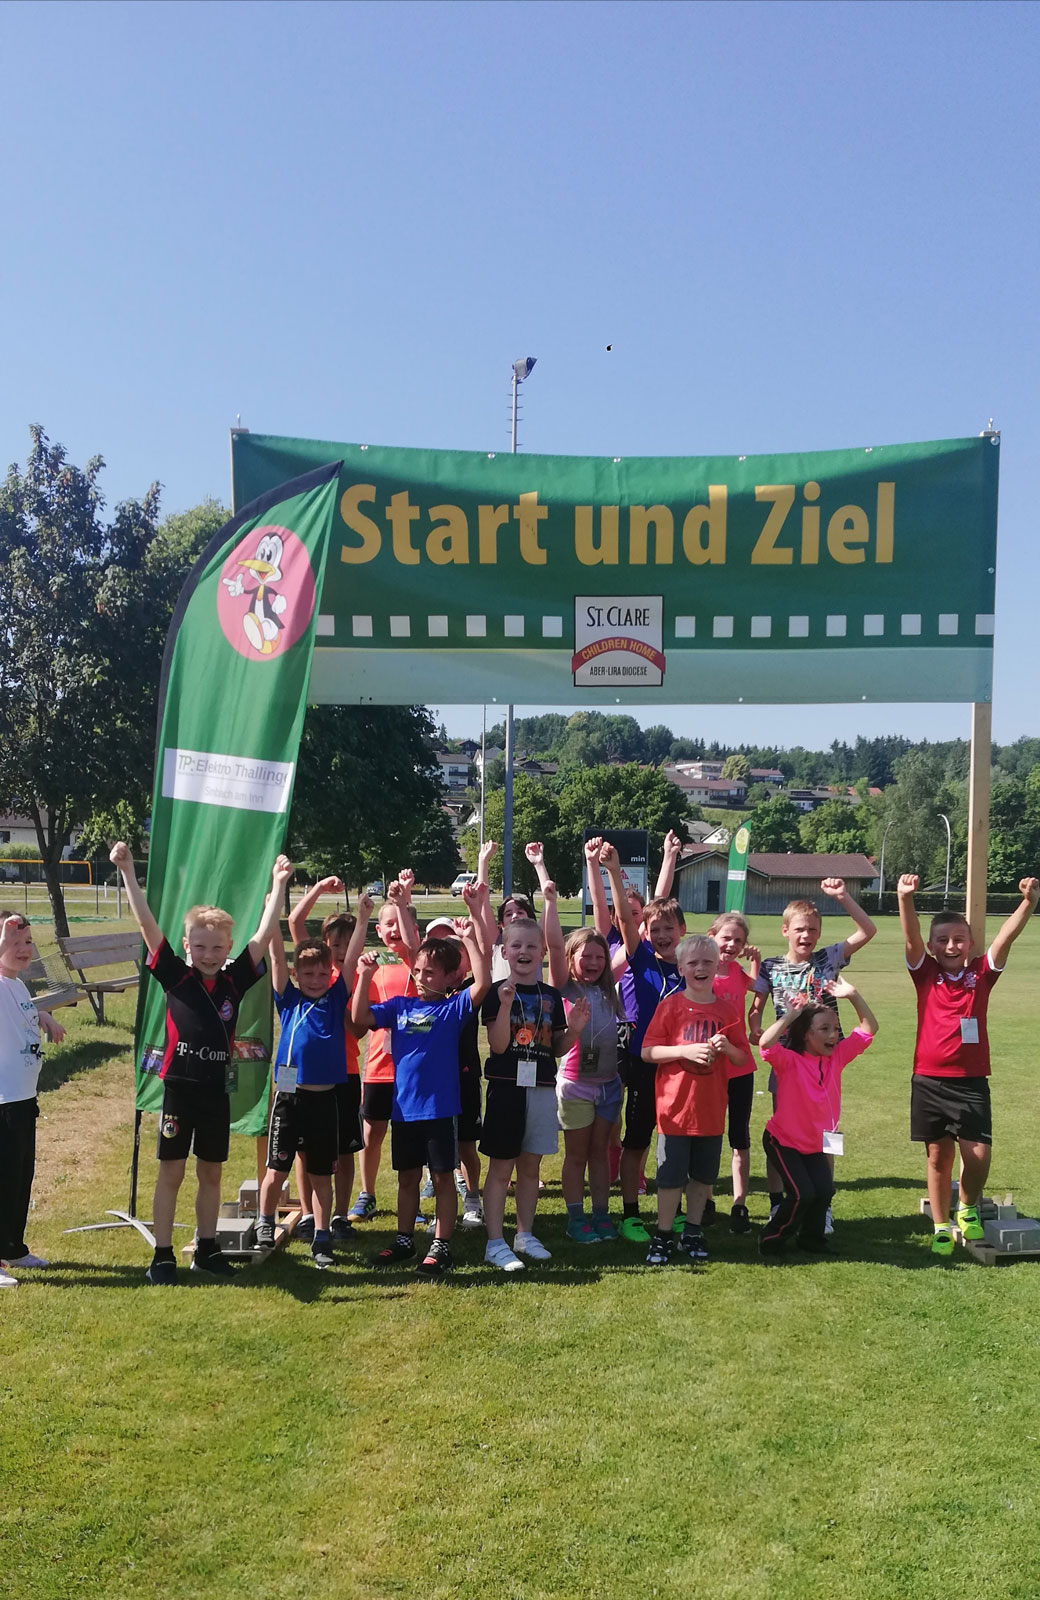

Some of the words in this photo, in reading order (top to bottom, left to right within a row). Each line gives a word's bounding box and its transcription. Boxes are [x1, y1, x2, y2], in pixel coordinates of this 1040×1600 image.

[340, 484, 549, 565] Start
[575, 485, 728, 566] und
[751, 481, 896, 565] Ziel
[581, 639, 627, 660] CHILDREN
[629, 640, 657, 660] HOME
[589, 666, 621, 676] ABER-LIRA
[622, 666, 648, 676] DIOCESE
[196, 760, 231, 776] Elektro
[271, 1116, 281, 1160] DEUTSCHLAND
